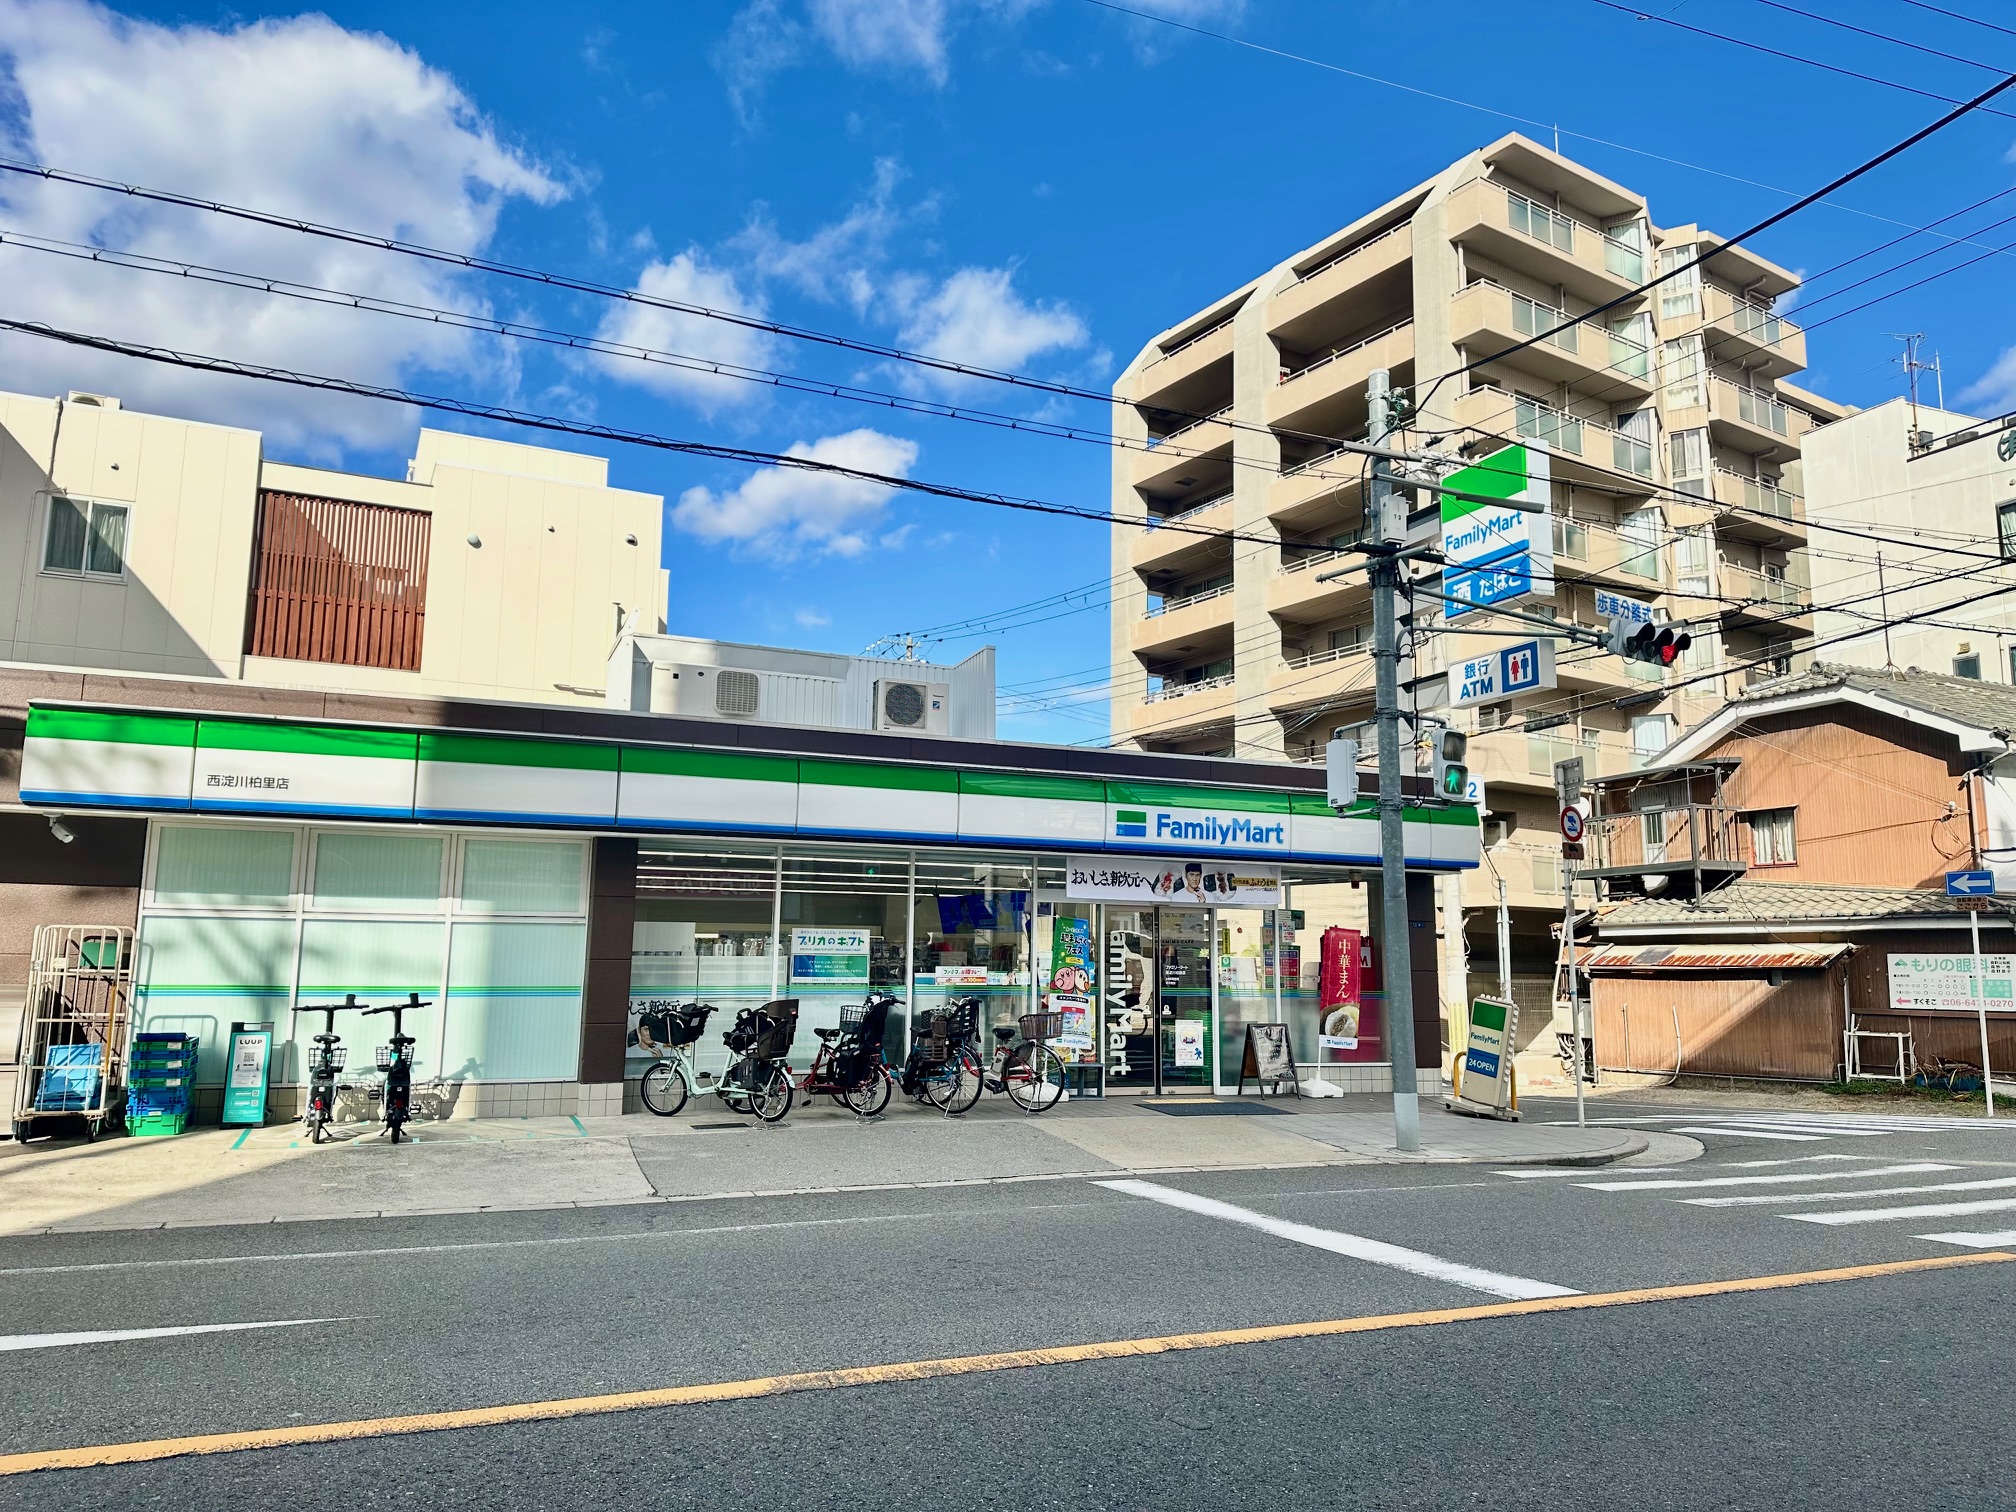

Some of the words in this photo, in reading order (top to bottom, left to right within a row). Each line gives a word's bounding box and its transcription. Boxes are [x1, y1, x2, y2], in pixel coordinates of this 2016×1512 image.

[1445, 510, 1522, 552] FamilyMart
[1452, 580, 1471, 610] 酒
[1479, 566, 1521, 598] たばこ
[1598, 594, 1652, 623] 歩車分離式
[1464, 659, 1490, 679] 銀行
[1460, 677, 1493, 699] ATM
[207, 774, 289, 789] 西淀川柏里店
[1468, 782, 1477, 797] 2
[1156, 813, 1284, 844] FamilyMart
[1071, 868, 1153, 888] おいしさ新次元へ
[1336, 939, 1351, 998] 中華まん
[1106, 914, 1133, 1076] FamilyMart
[1471, 1032, 1500, 1045] FamilyMart
[1468, 1058, 1476, 1066] 24
[1477, 1060, 1494, 1072] OPEN
